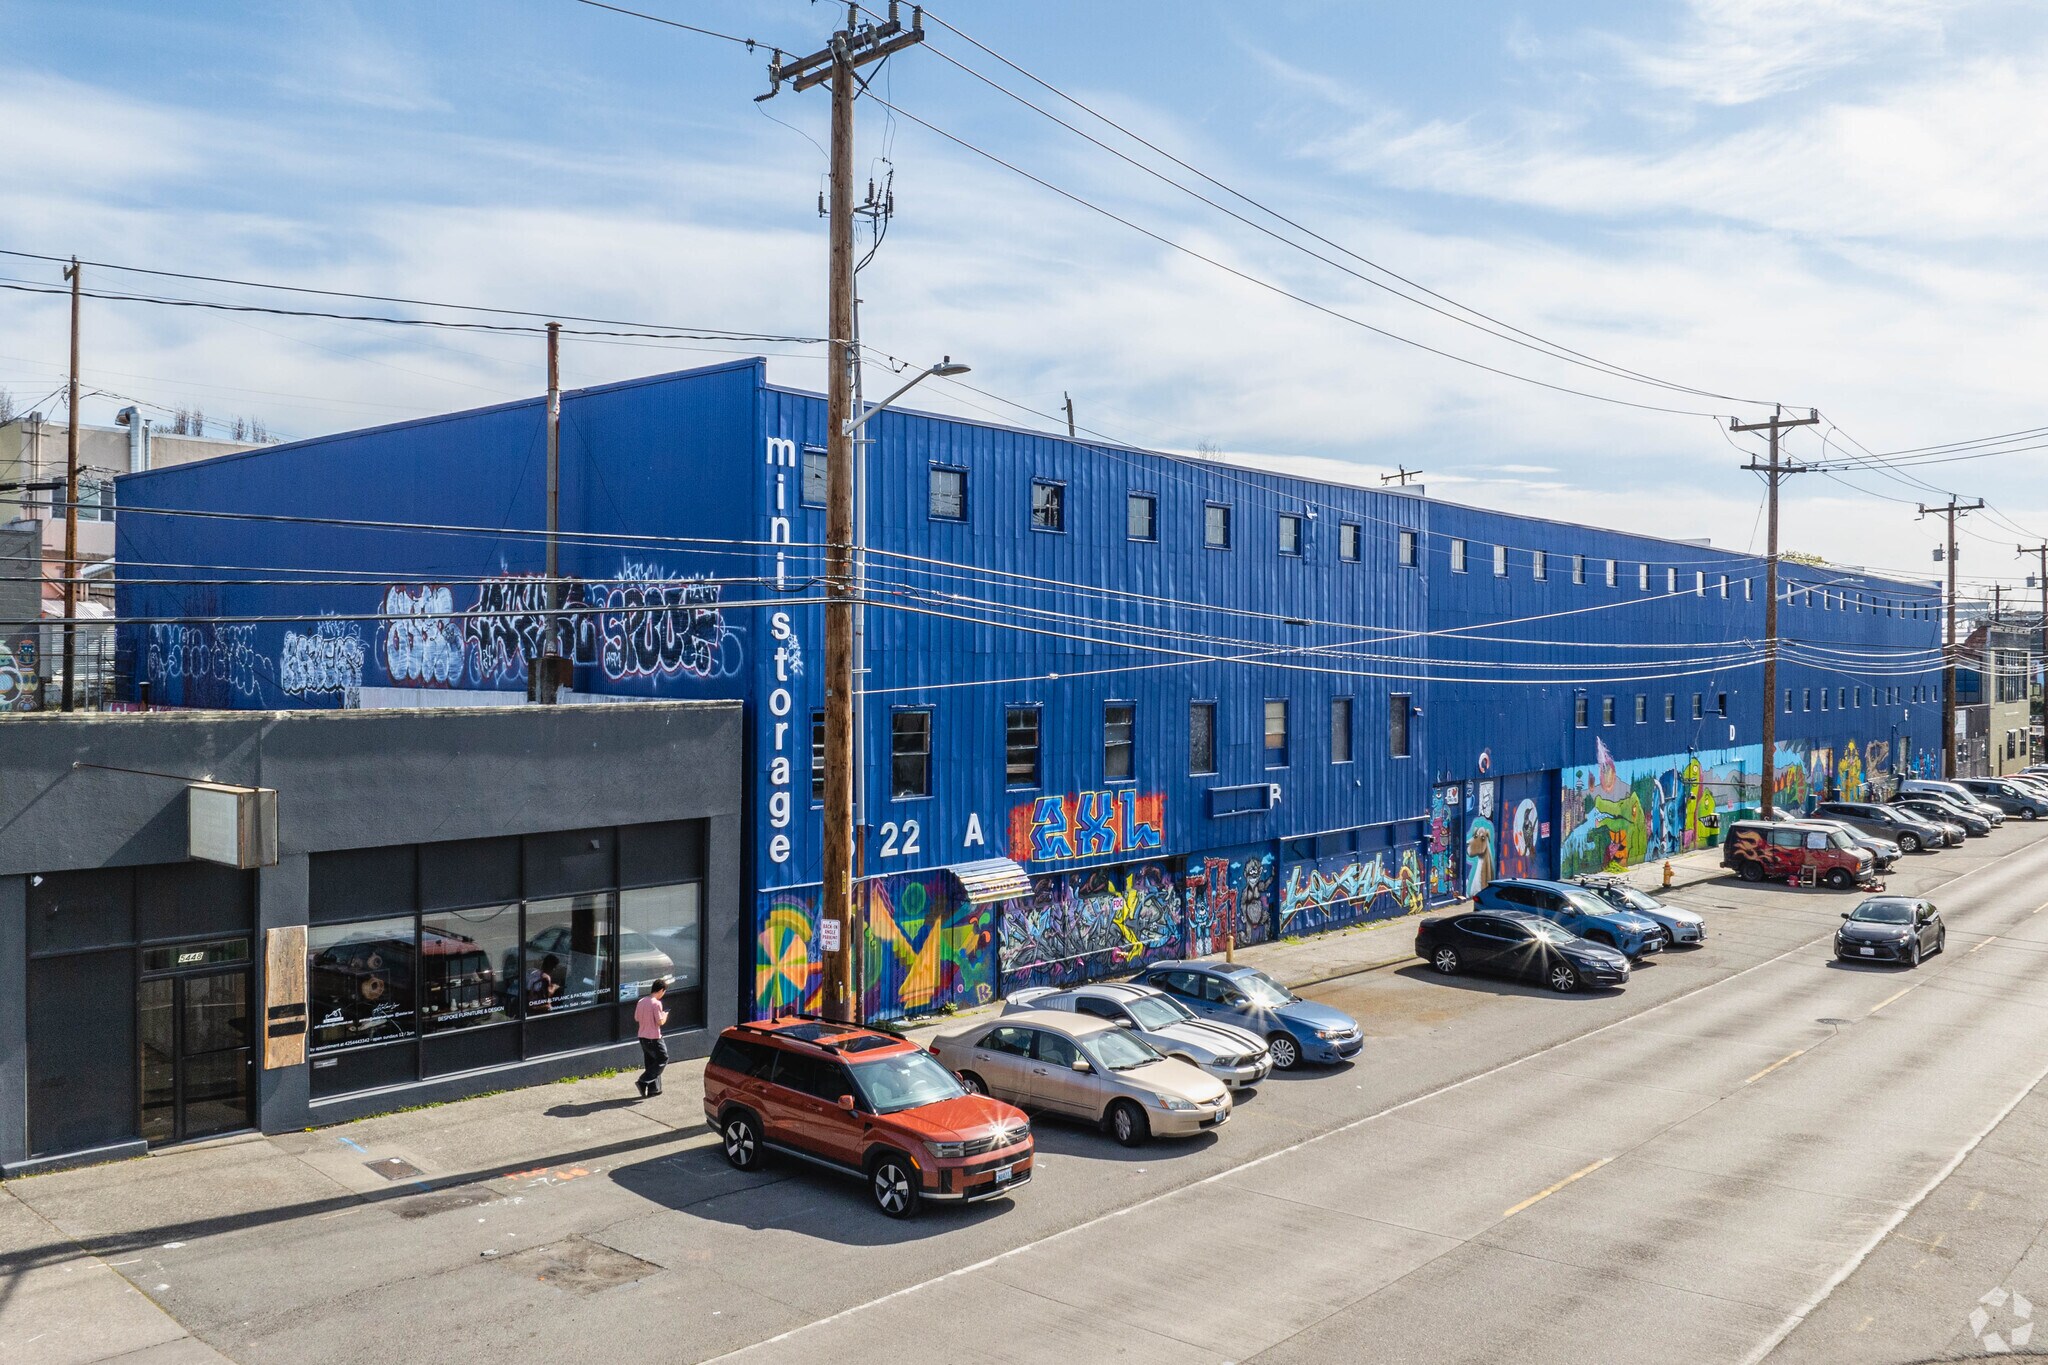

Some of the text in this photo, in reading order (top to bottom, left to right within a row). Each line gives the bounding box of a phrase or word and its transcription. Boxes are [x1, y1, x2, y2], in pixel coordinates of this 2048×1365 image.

[767, 437, 795, 863] mini storage
[1729, 725, 1735, 740] D
[963, 812, 984, 847] A
[437, 1013, 458, 1022] BESPOKE
[458, 1009, 484, 1018] FURNITURE
[315, 1043, 340, 1051] appointment
